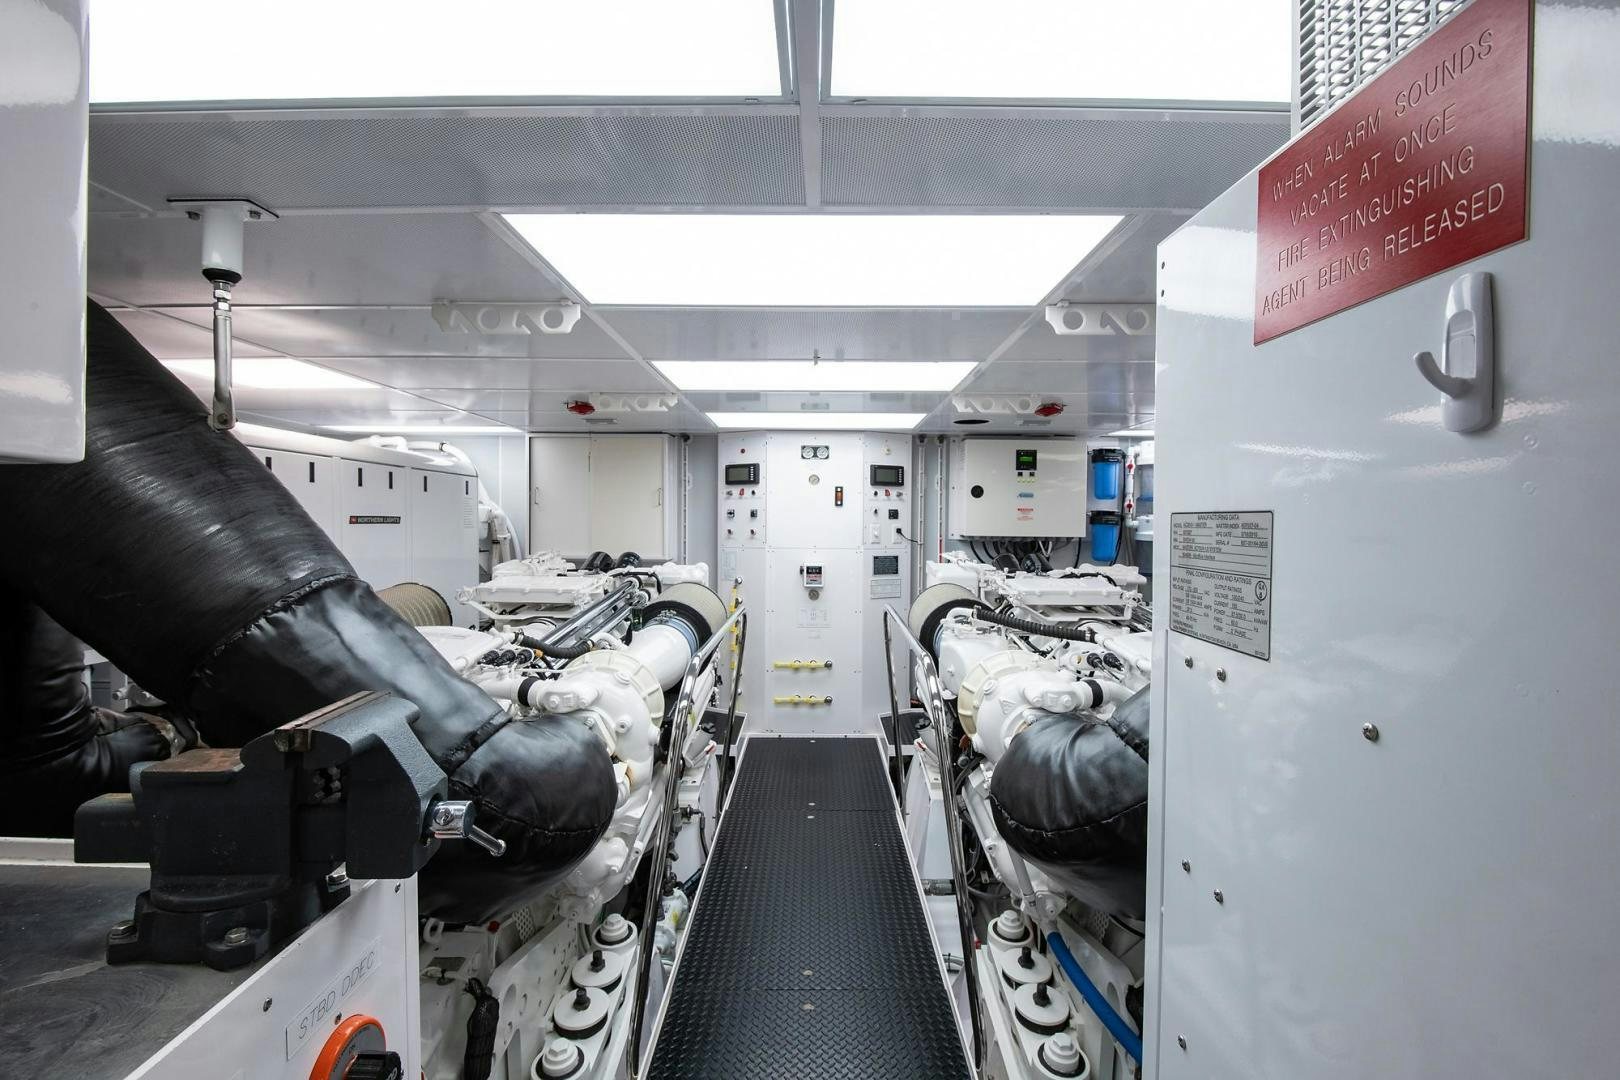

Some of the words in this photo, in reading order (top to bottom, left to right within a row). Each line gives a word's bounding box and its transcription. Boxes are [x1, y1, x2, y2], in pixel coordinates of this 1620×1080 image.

[1272, 158, 1313, 203] WHEN
[1323, 108, 1382, 168] ALARM
[1394, 28, 1493, 117] SOUNDS
[1289, 175, 1348, 227] VACATE
[1359, 152, 1381, 186] AT
[1394, 103, 1457, 164] ONCE
[1262, 275, 1308, 317] AGENT
[1318, 247, 1370, 290] BEING
[1383, 182, 1505, 261] RELEASED
[1277, 237, 1309, 272] FIRE
[1319, 145, 1475, 251] EXTINGUISHING
[298, 990, 336, 1040] STBD
[341, 951, 375, 997] DDEC
